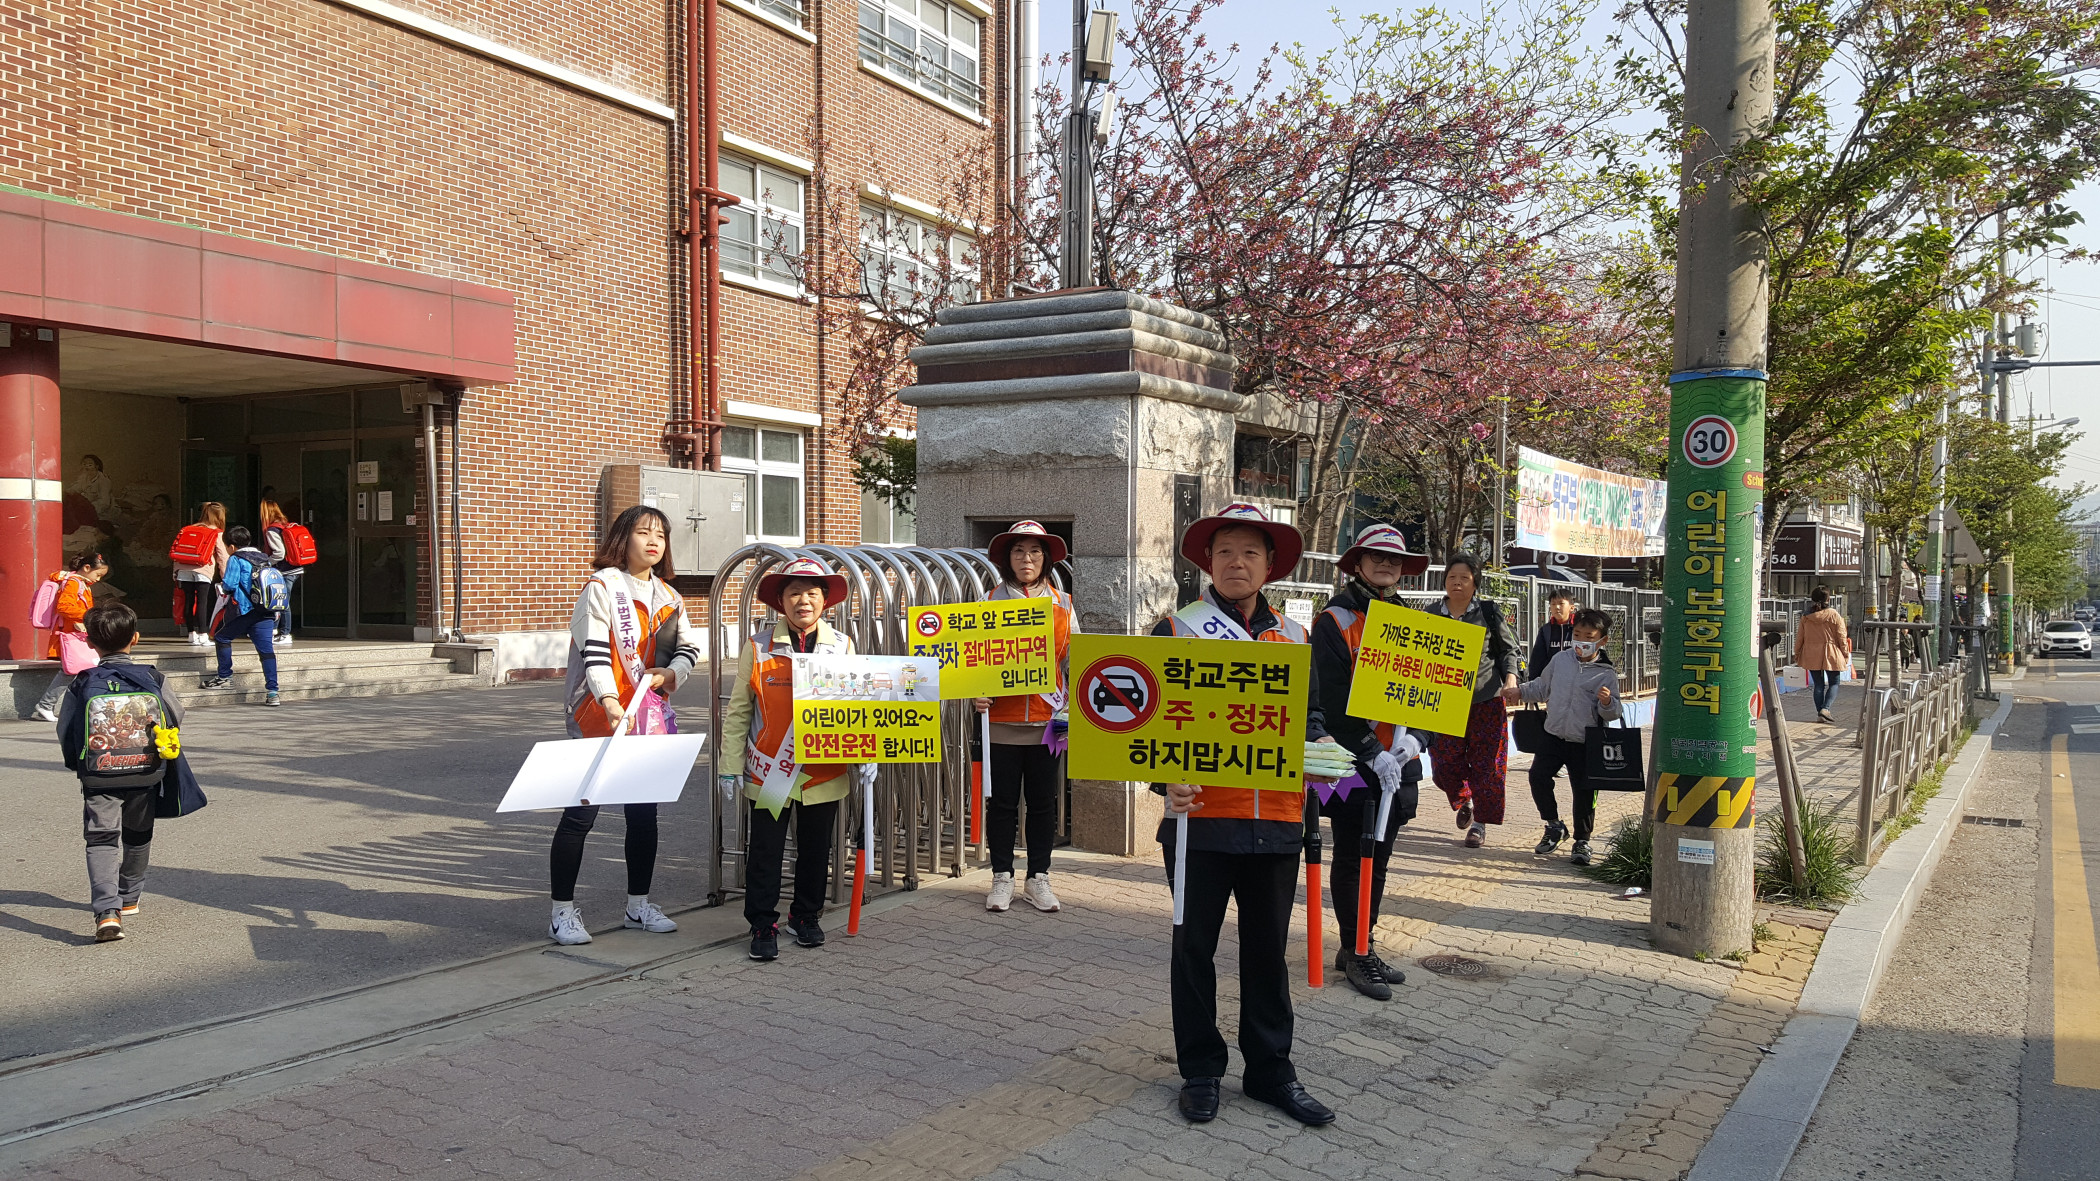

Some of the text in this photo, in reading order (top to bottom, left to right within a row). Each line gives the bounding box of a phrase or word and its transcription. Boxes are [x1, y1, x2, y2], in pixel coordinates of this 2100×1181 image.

[1693, 429, 1727, 453] 30
[1553, 473, 1577, 522] 탁구부
[948, 607, 1046, 632] 학교 앞 도로는
[1678, 490, 1727, 715] 어린이보호구역
[615, 591, 636, 650] 불법주차
[963, 635, 1048, 668] 절대금지구역
[1380, 622, 1465, 661] 가까운 주차장 또는
[1001, 667, 1048, 688] 입니다!
[1163, 657, 1290, 695] 학교주변
[1360, 646, 1475, 691] 주차가 허용된 이면도로에
[1384, 681, 1442, 712] 주차 합시다!
[802, 707, 934, 728] 어린이가 있어요~
[1163, 700, 1195, 730] 주
[1225, 703, 1290, 736] 정차
[802, 733, 935, 759] 안전운전 합시다!
[1128, 739, 1296, 778] 하지맙시다.
[1603, 745, 1625, 761] 01
